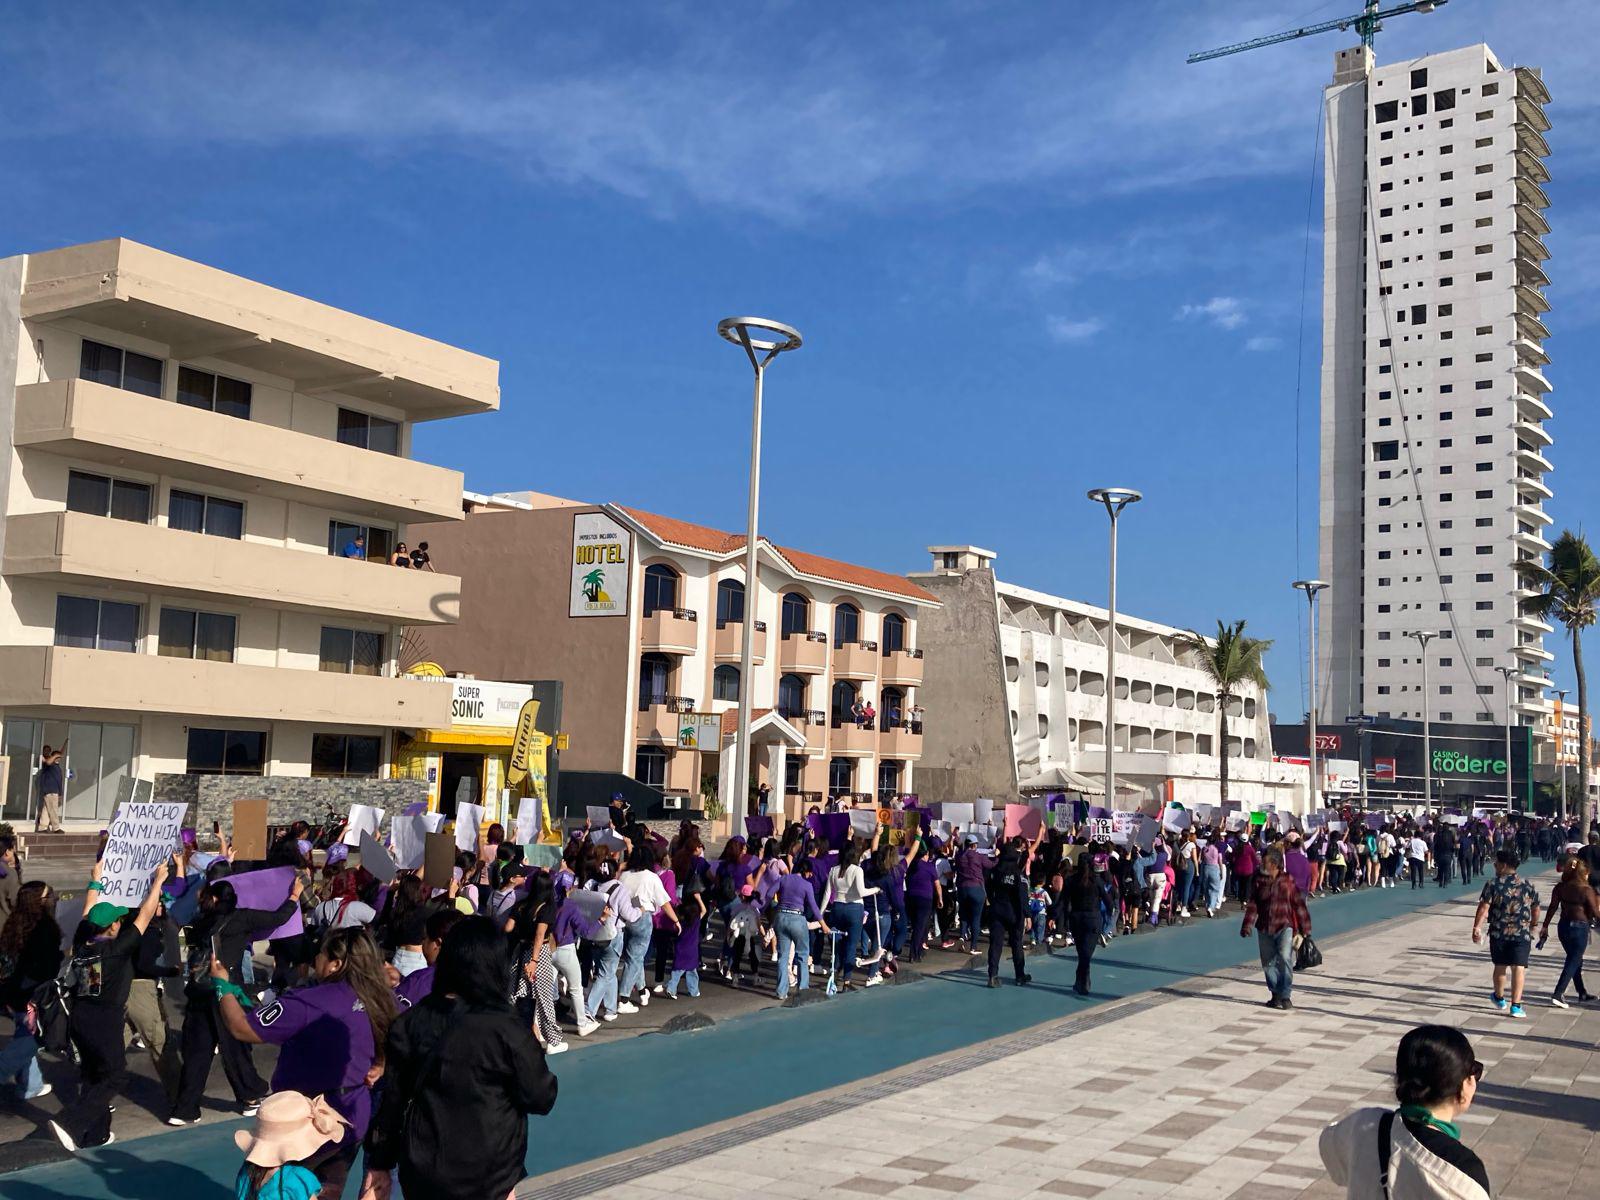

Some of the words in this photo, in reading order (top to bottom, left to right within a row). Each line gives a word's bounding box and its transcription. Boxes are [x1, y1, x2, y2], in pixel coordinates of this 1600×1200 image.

[575, 543, 625, 565] HOTEL
[458, 686, 480, 699] SUPER
[452, 699, 484, 719] SONIC
[683, 714, 716, 726] HOTEL
[1432, 750, 1460, 759] CASINO
[127, 804, 179, 820] MARCHO
[111, 821, 135, 838] CON
[136, 824, 152, 839] MI
[1095, 818, 1108, 826] YO
[106, 838, 129, 856] PARA
[103, 857, 123, 874] NO
[98, 876, 122, 897] POR
